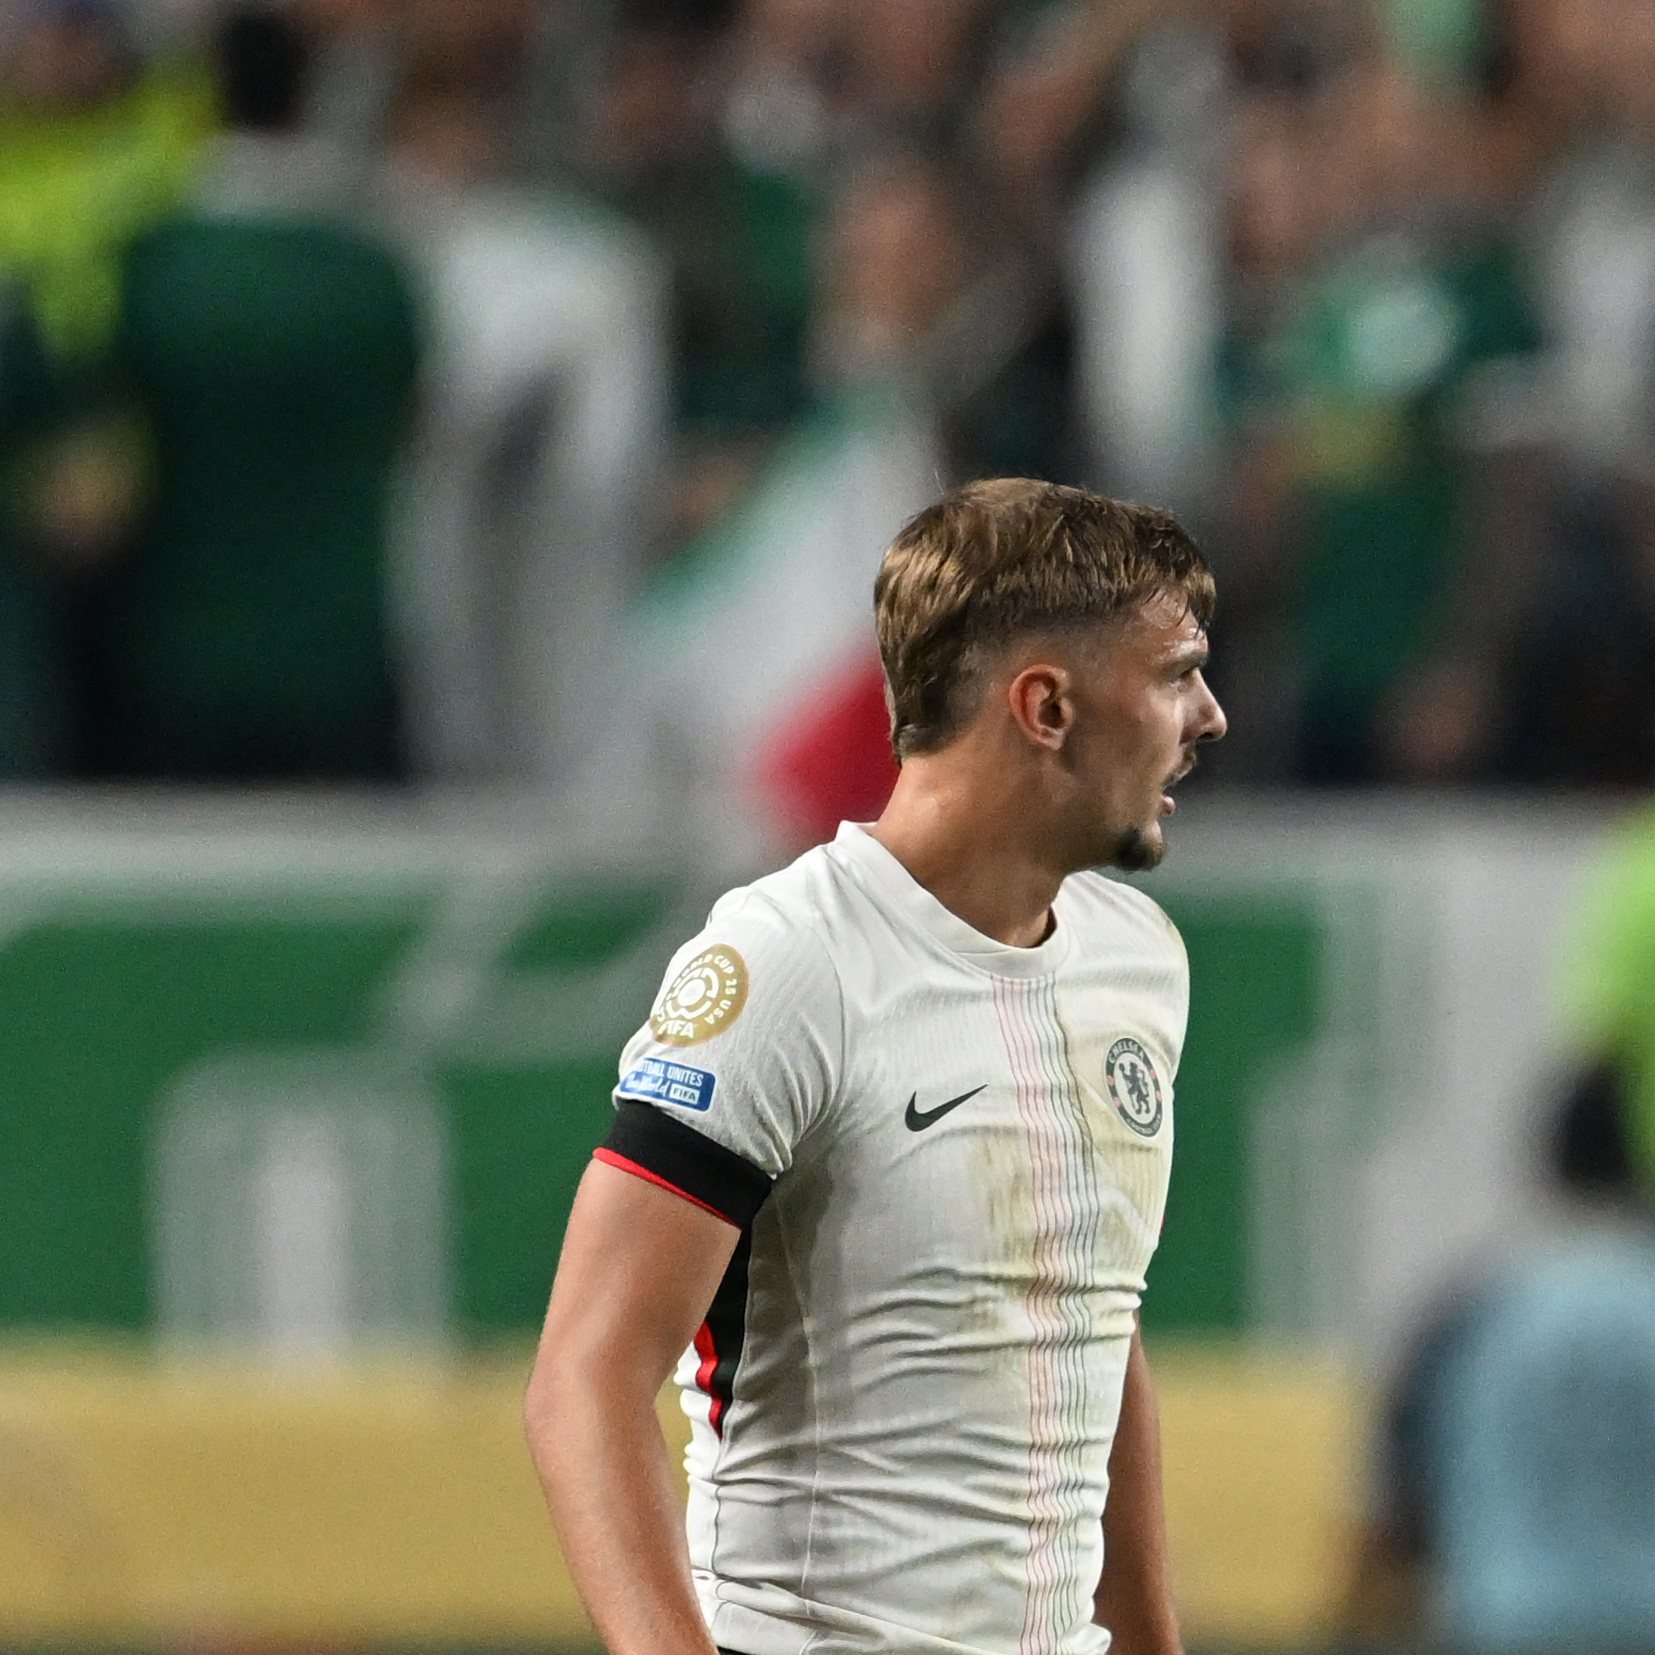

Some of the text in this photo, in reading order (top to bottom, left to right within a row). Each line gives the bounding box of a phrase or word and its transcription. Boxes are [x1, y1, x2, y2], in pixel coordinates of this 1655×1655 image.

[713, 954, 735, 974] CUP
[704, 999, 732, 1024] USA
[667, 1064, 704, 1087] UNITES
[672, 1087, 697, 1102] FIFA
